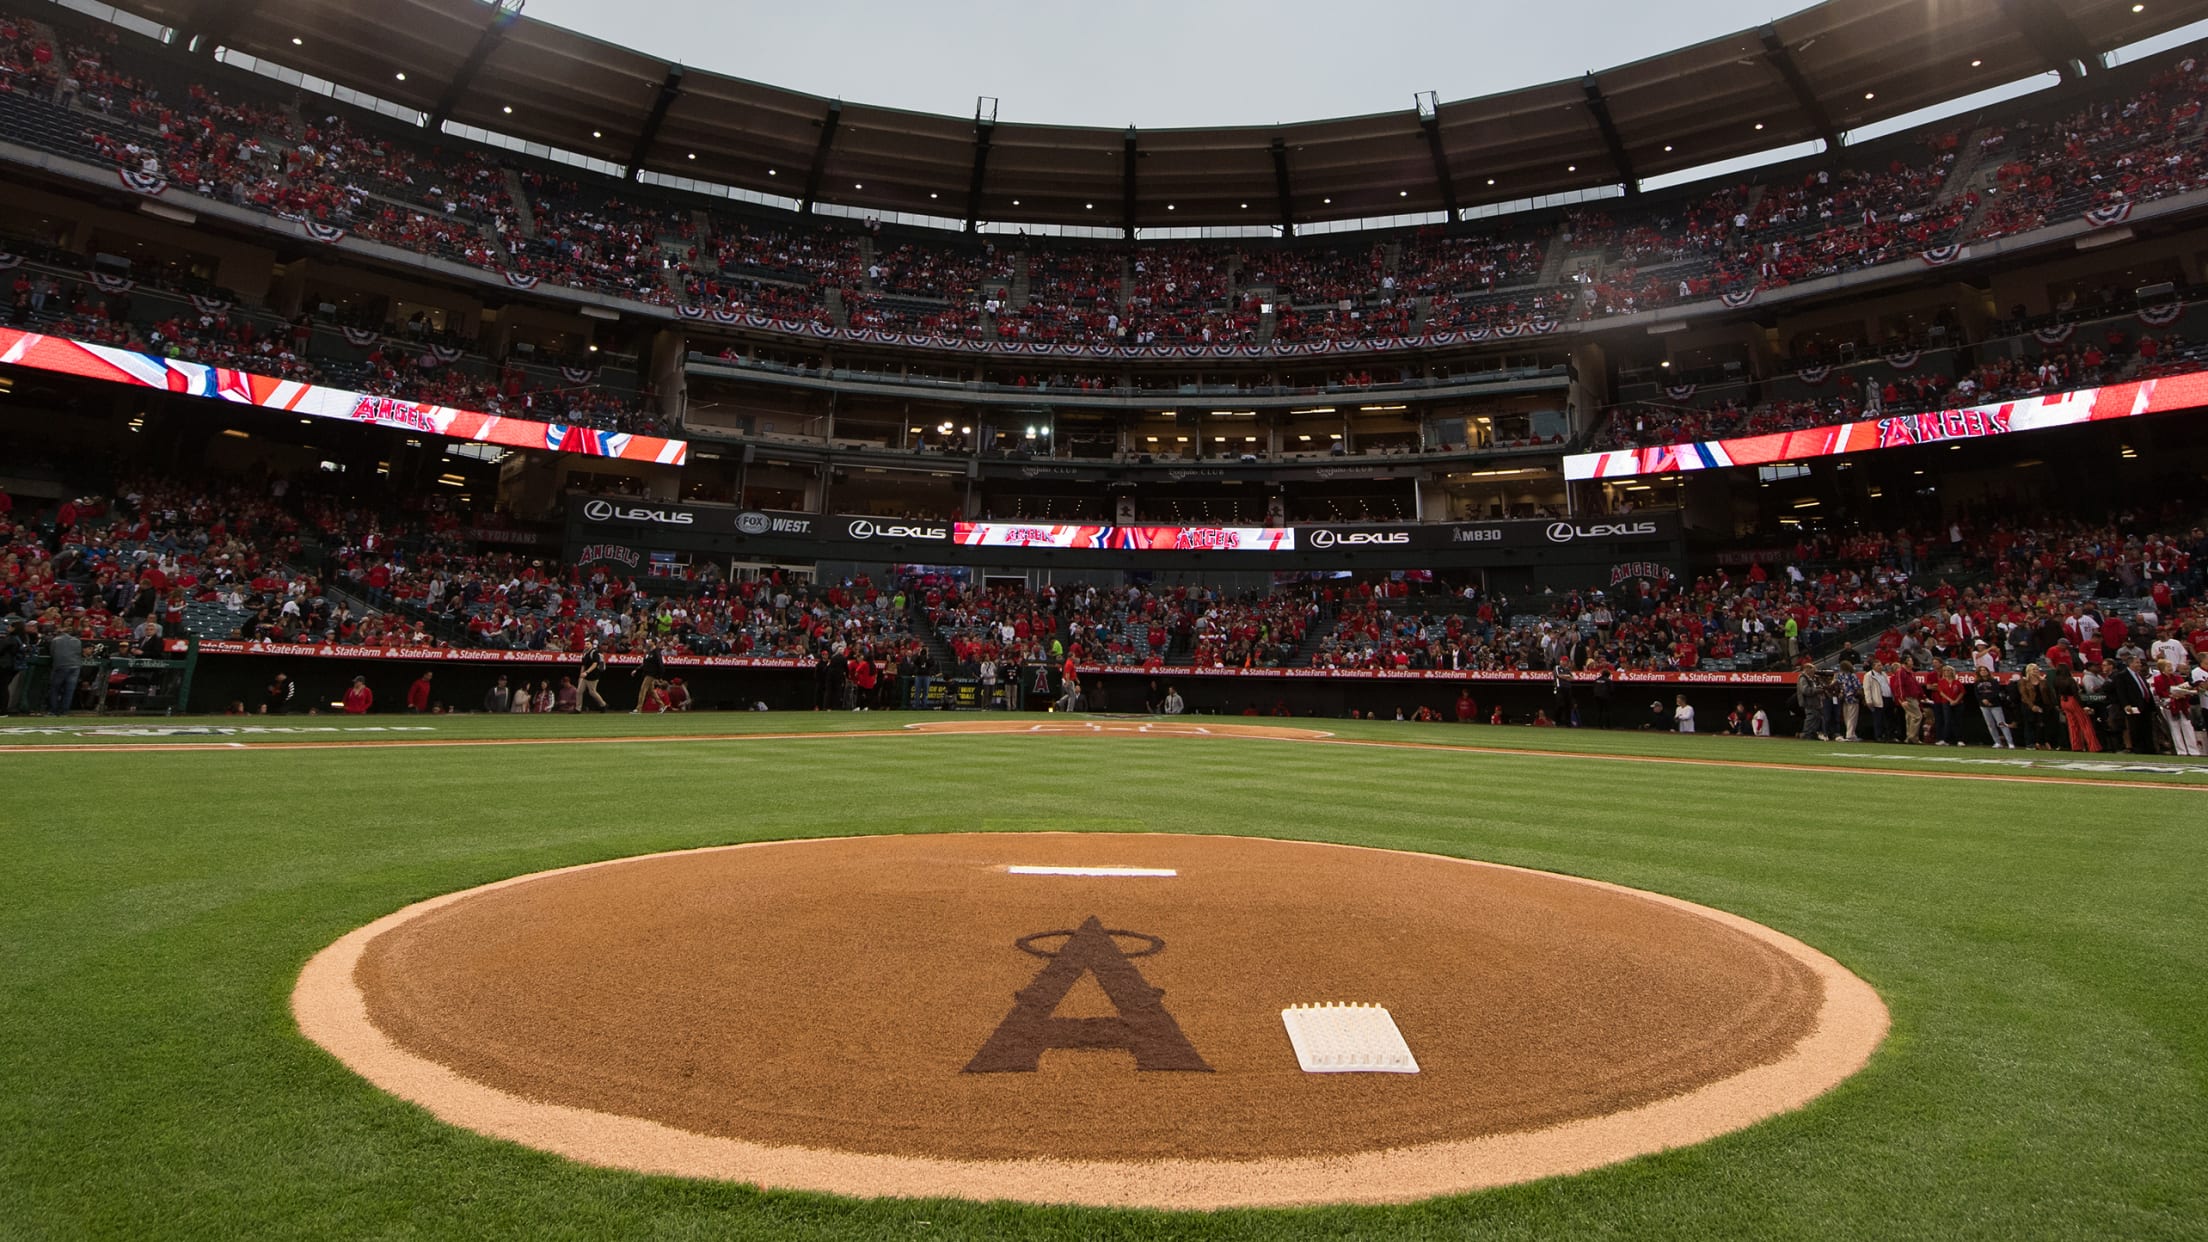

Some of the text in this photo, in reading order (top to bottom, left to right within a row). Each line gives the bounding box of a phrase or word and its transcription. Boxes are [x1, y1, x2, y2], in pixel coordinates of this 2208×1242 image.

[351, 396, 435, 433] ANGELS
[1878, 409, 2011, 448] ANGELS
[615, 506, 694, 524] LEXUS
[743, 516, 810, 534] FOX WEST
[876, 525, 947, 540] LEXUS
[1176, 527, 1239, 549] ANGELS
[1337, 532, 1410, 545] LEXUS
[1575, 522, 1657, 537] LEXUS
[578, 543, 641, 569] ANGELS
[1610, 561, 1670, 587] ANGELS
